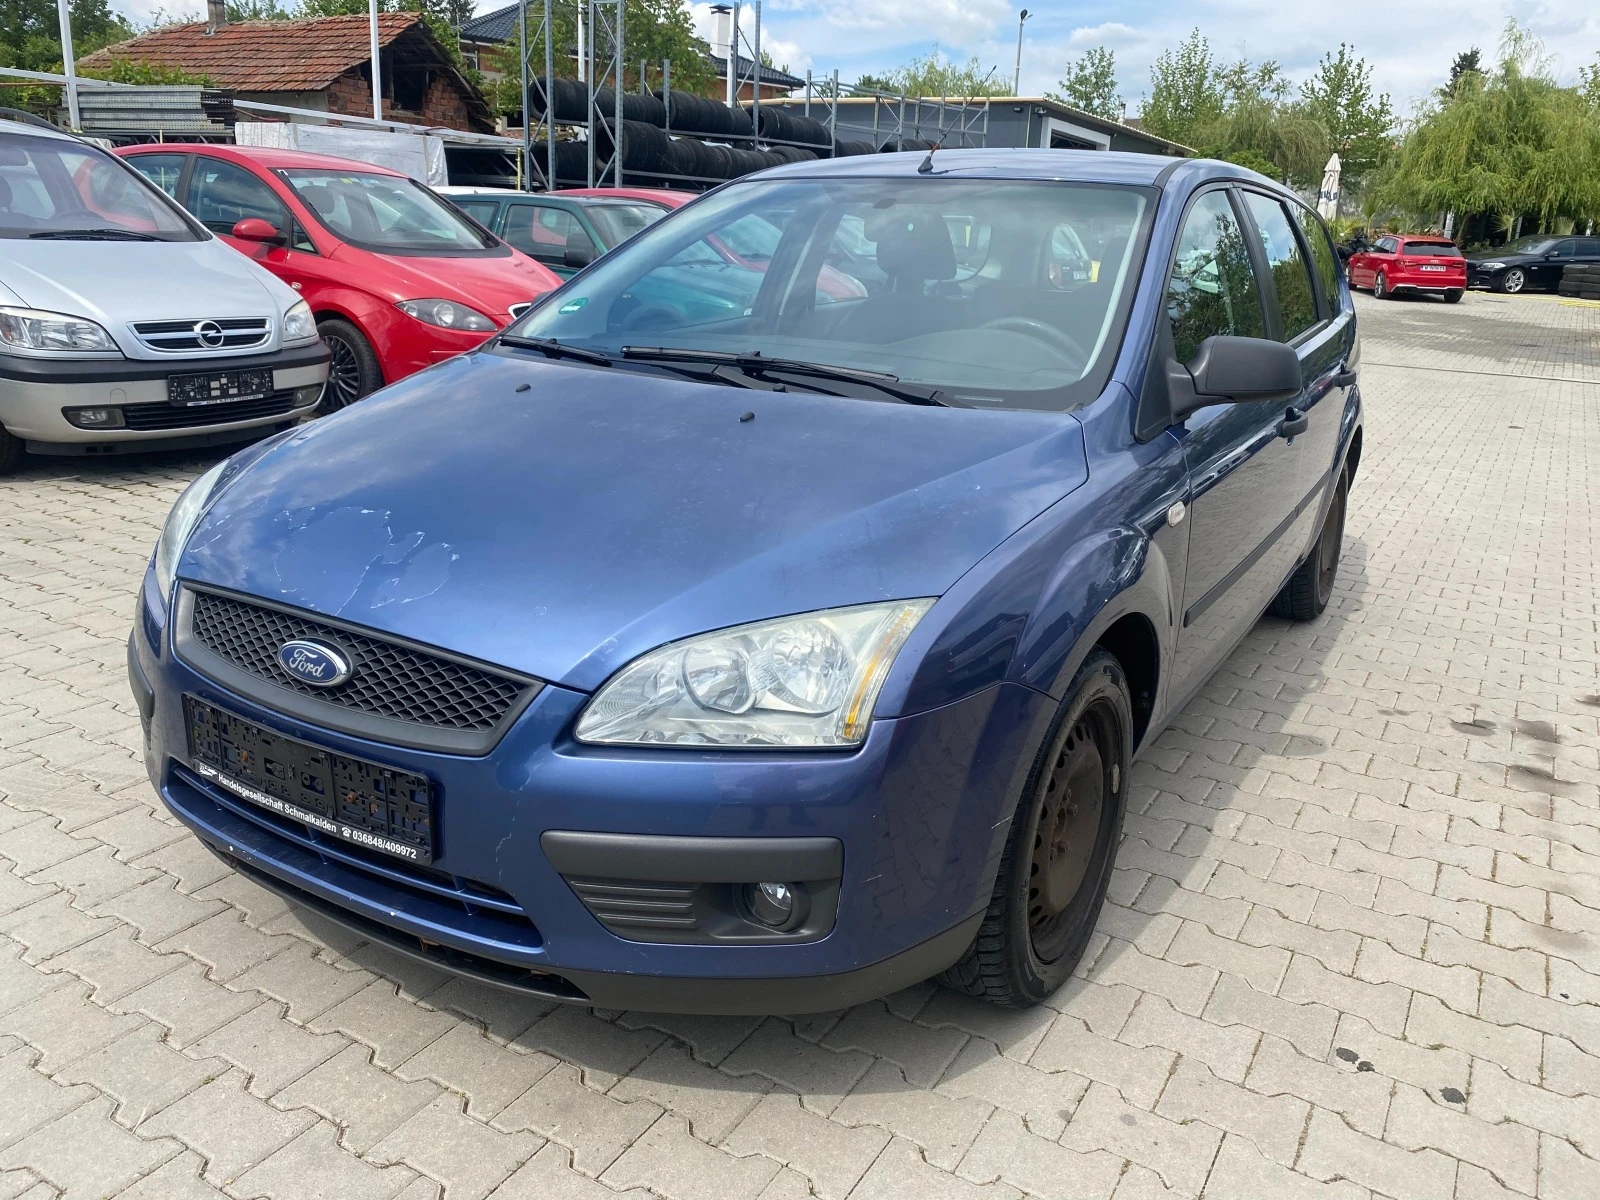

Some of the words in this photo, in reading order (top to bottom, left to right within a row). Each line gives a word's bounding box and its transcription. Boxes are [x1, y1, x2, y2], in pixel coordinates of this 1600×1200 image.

[289, 648, 326, 677] Ford
[218, 773, 284, 812] Handelsgesellschaft
[284, 804, 337, 833] Schmalkalden
[352, 830, 417, 859] 036848/409972
